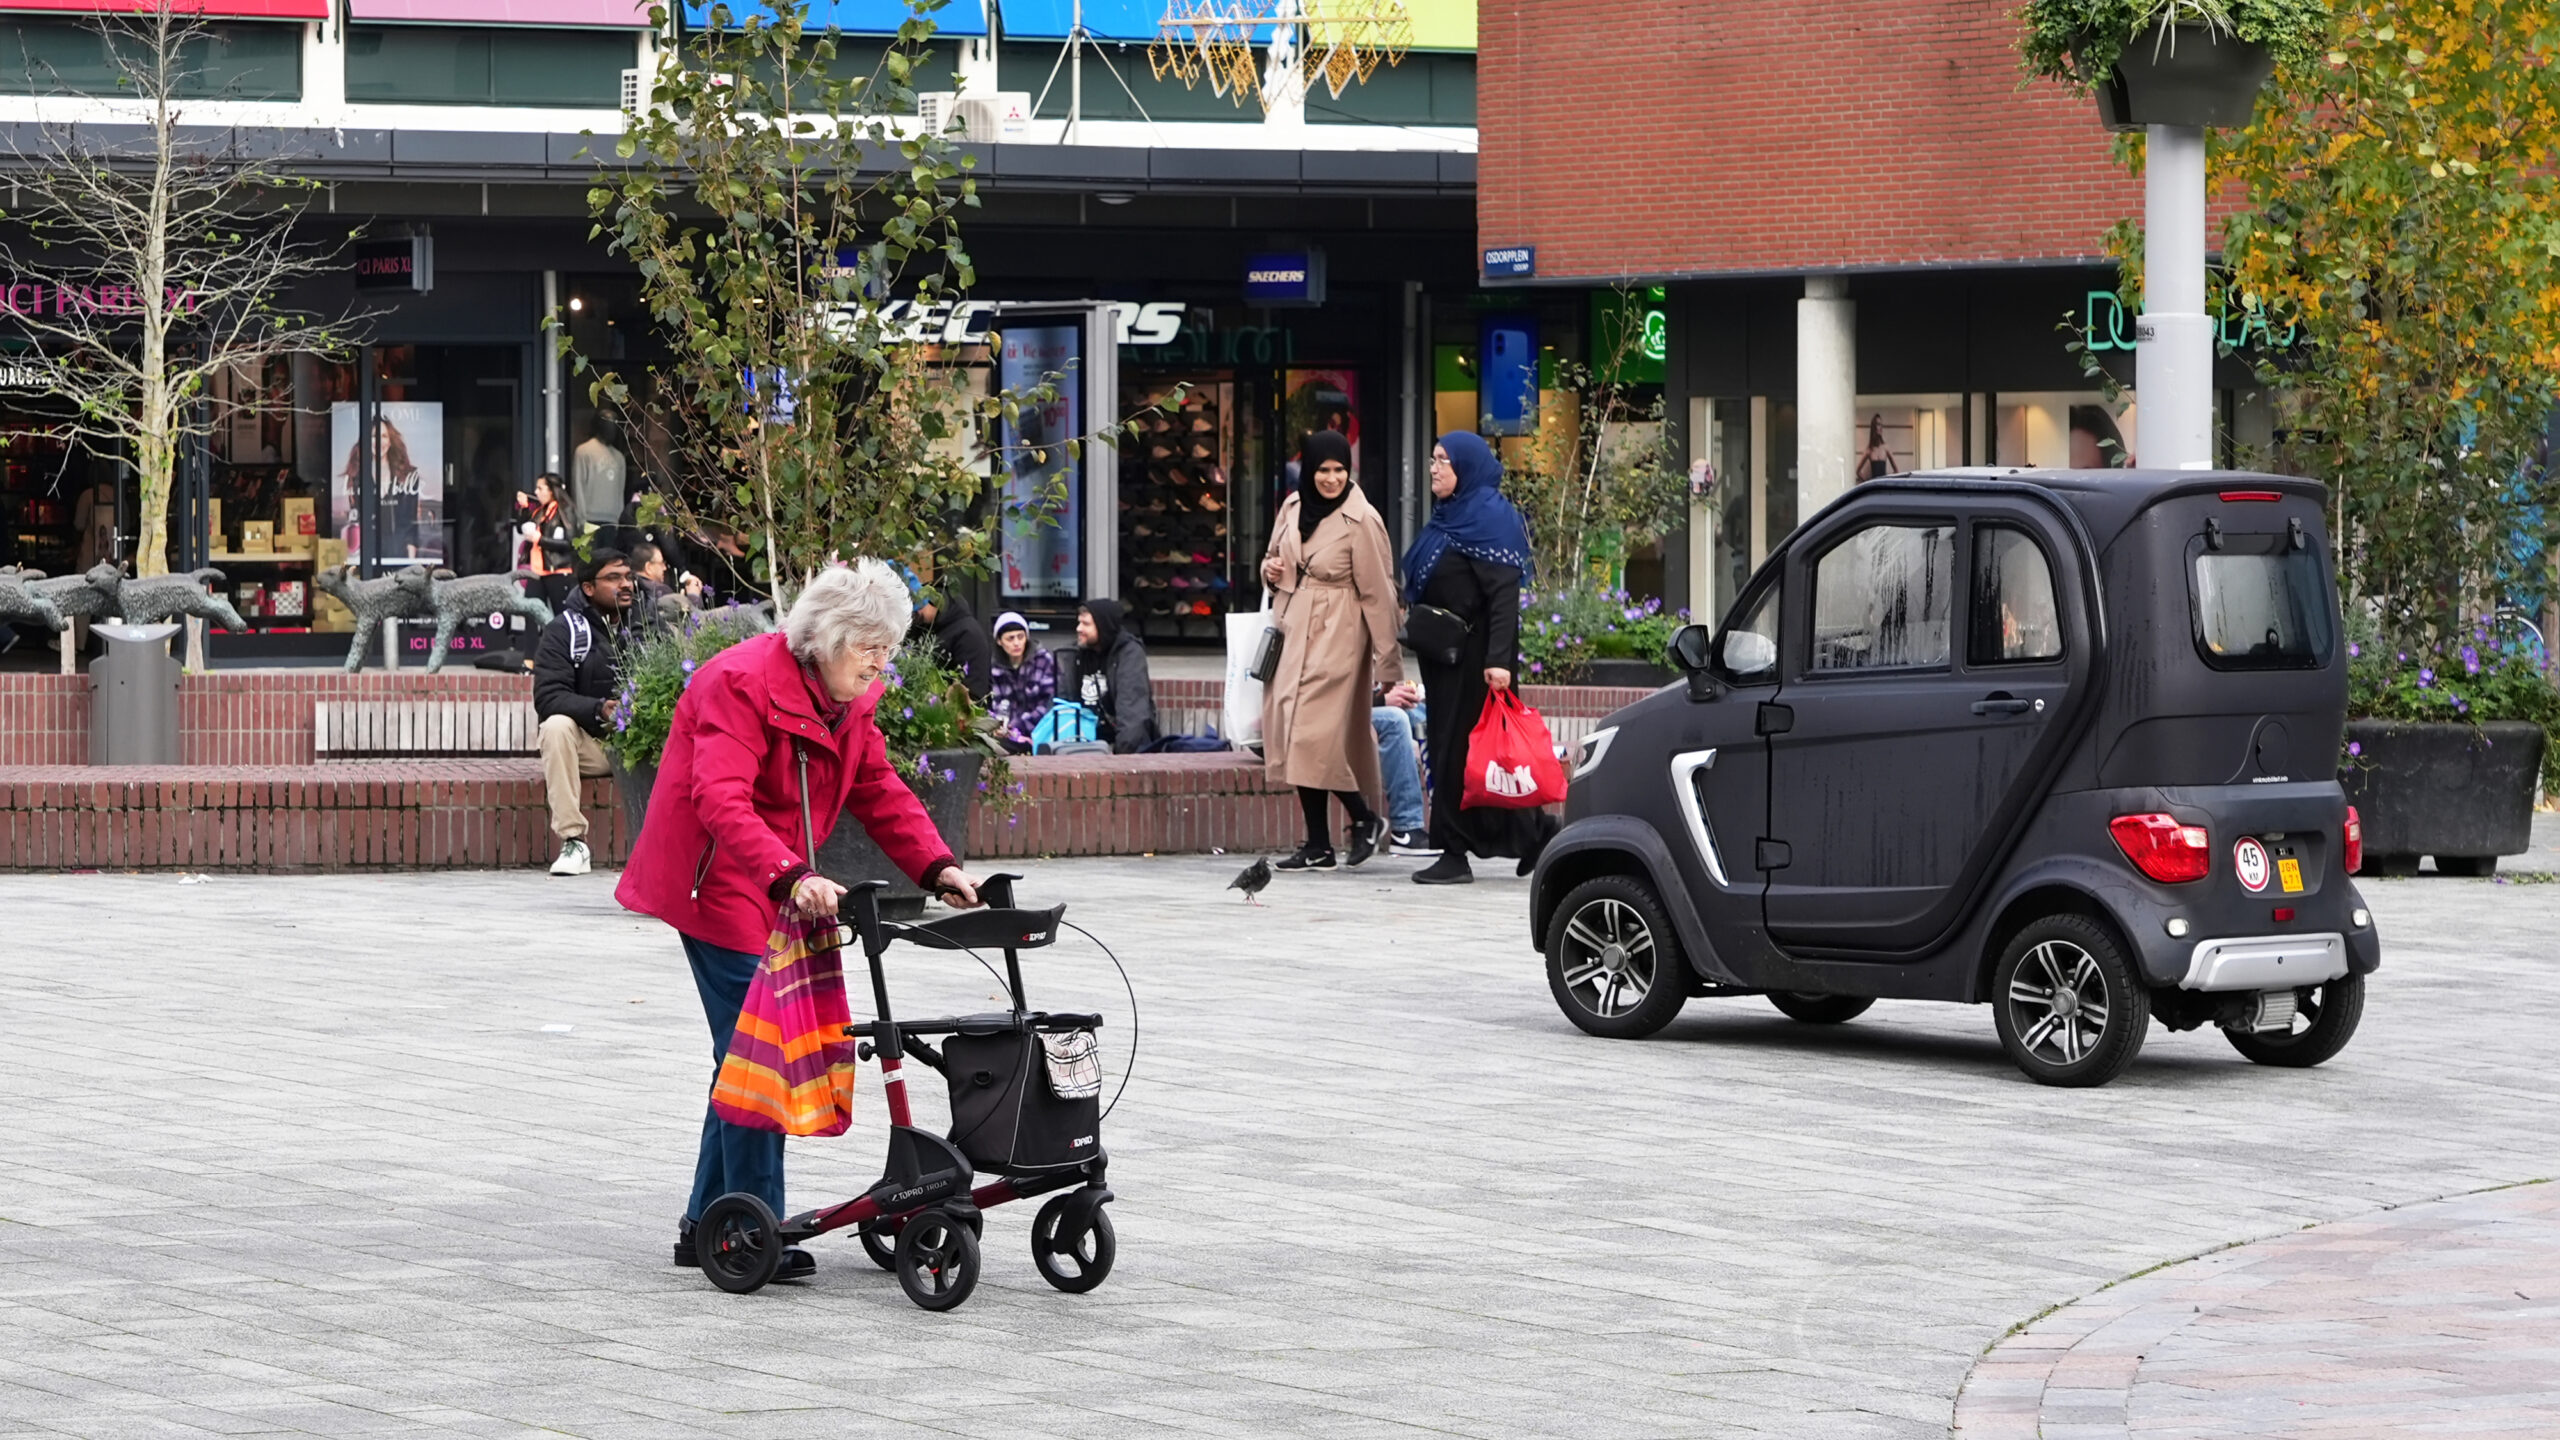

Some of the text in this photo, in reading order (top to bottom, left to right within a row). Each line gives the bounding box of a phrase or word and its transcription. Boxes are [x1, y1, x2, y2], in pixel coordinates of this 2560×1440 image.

[373, 257, 399, 274] PARIS
[1248, 270, 1305, 282] SKECHERS
[410, 637, 428, 650] ICI
[470, 637, 486, 649] XL
[1485, 760, 1538, 796] Dirk
[2242, 847, 2259, 867] 45
[2280, 862, 2298, 873] JGN
[2248, 872, 2259, 881] KM
[898, 1186, 924, 1200] TOPRO
